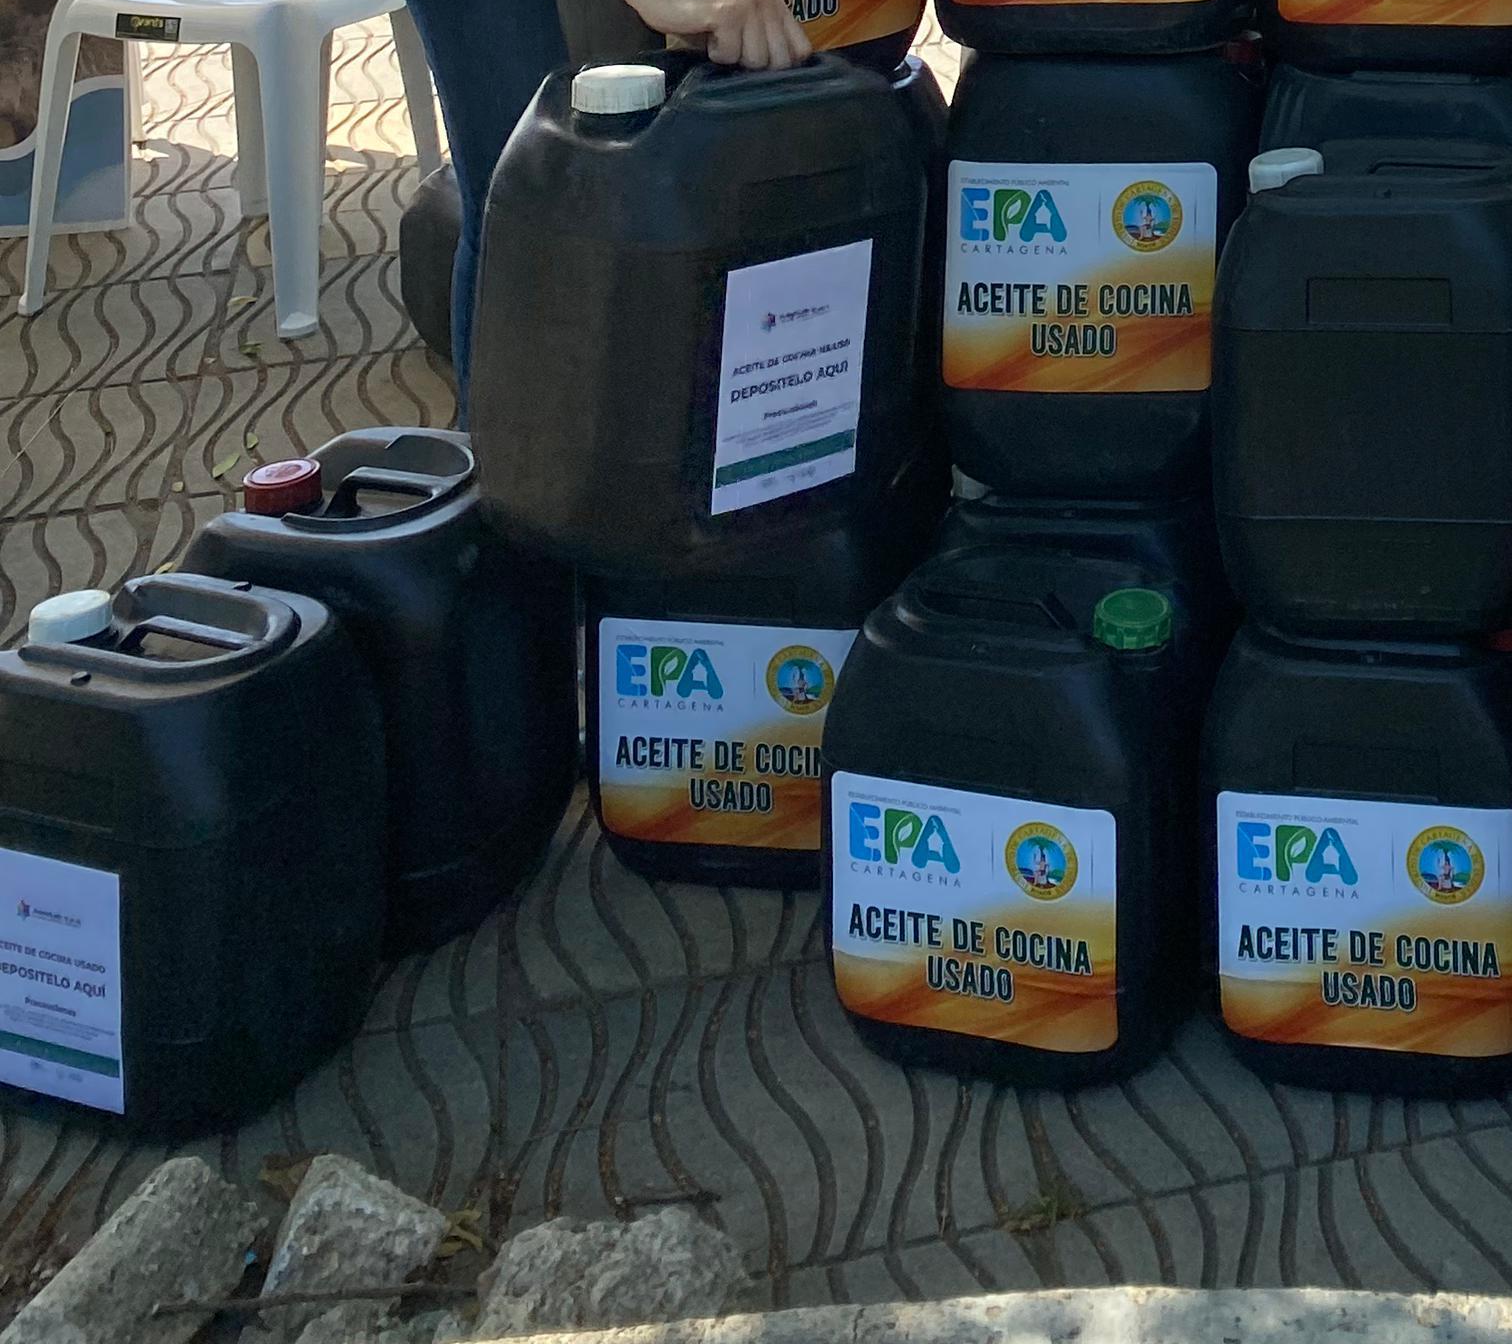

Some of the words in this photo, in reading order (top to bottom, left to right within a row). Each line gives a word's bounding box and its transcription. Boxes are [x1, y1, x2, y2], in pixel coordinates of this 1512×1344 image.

[960, 188, 1068, 243] EPA
[961, 243, 1069, 256] CARTAGENA
[957, 281, 1047, 316] ACEITE
[1056, 284, 1089, 316] DE
[1099, 284, 1194, 317] COCINA
[1031, 323, 1117, 356] USADO
[616, 644, 724, 700] EPA
[618, 698, 724, 713] CARTAGENA
[616, 735, 705, 771] ACEITE
[714, 740, 746, 773] DE
[689, 778, 773, 813] USADO
[850, 802, 960, 874] EPA
[1236, 822, 1359, 885] EPA
[850, 862, 961, 888] CARTAGENA
[1239, 883, 1359, 899] CARTAGENA
[0, 940, 22, 954] CEITE
[849, 903, 942, 948] ACEITE
[952, 918, 985, 956] DE
[995, 926, 1093, 976] COCINA
[1237, 925, 1339, 963] ACEITE
[1349, 929, 1385, 966] DE
[1395, 934, 1501, 978] COCINA
[0, 964, 71, 990] EPOSITELO
[926, 954, 1014, 1003] USADO
[1322, 971, 1417, 1013] USADO
